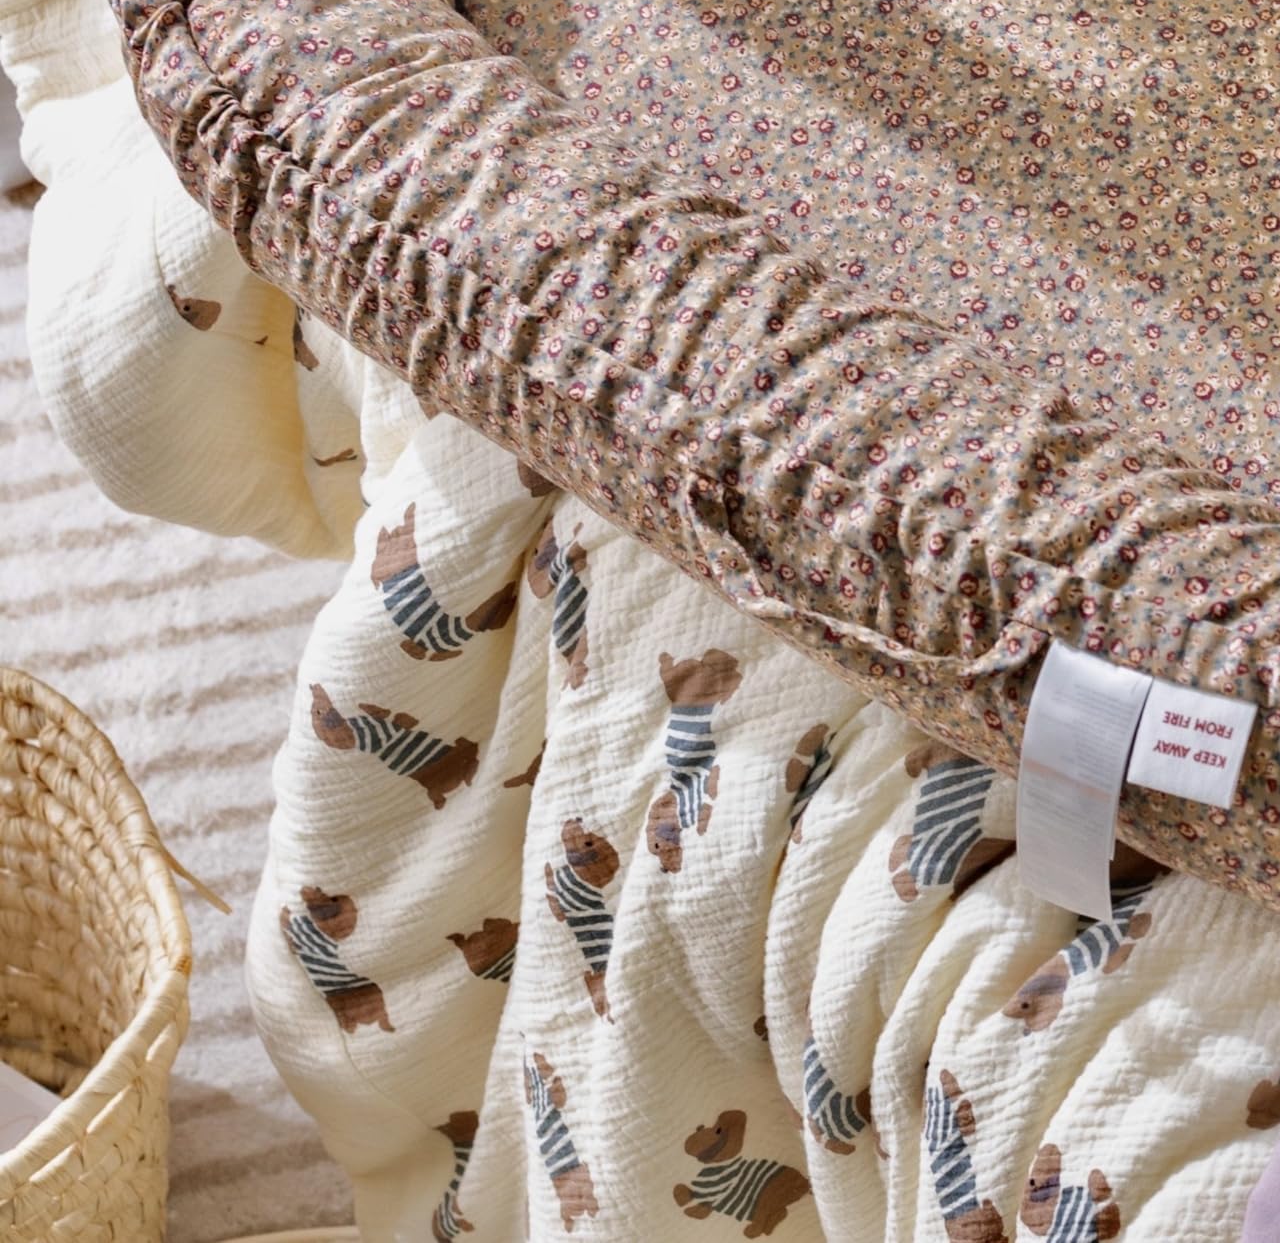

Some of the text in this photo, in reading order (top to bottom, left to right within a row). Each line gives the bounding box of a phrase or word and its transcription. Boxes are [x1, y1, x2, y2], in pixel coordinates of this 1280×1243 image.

[1162, 711, 1234, 740] FROM FIRE
[1152, 740, 1227, 768] KEEP AWAY
